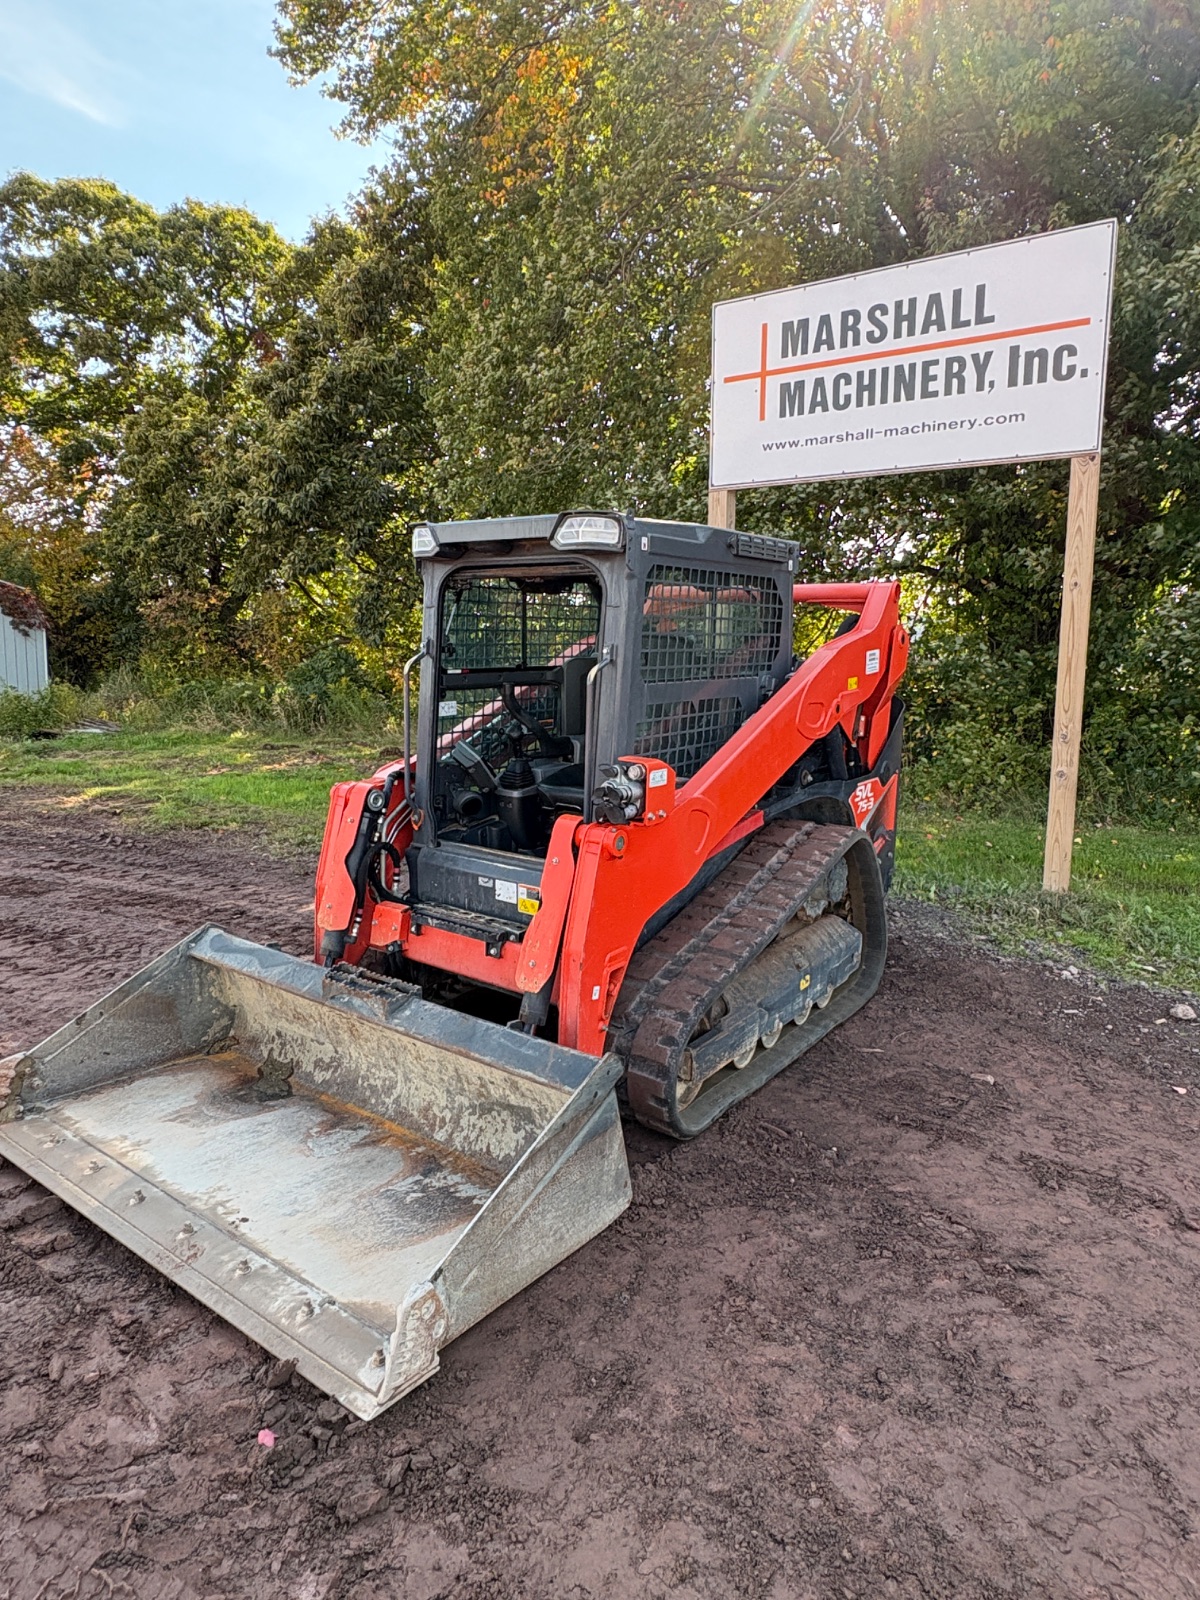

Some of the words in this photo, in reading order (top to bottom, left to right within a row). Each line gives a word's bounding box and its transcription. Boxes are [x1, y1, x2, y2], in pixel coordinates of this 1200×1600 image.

[781, 283, 995, 358] MARSHALL
[779, 350, 995, 418] MACHINERY,
[1007, 343, 1089, 388] Inc.
[762, 412, 1026, 451] www.marshall-machinery.com
[854, 783, 874, 802] SVL
[857, 797, 875, 814] 75-3
